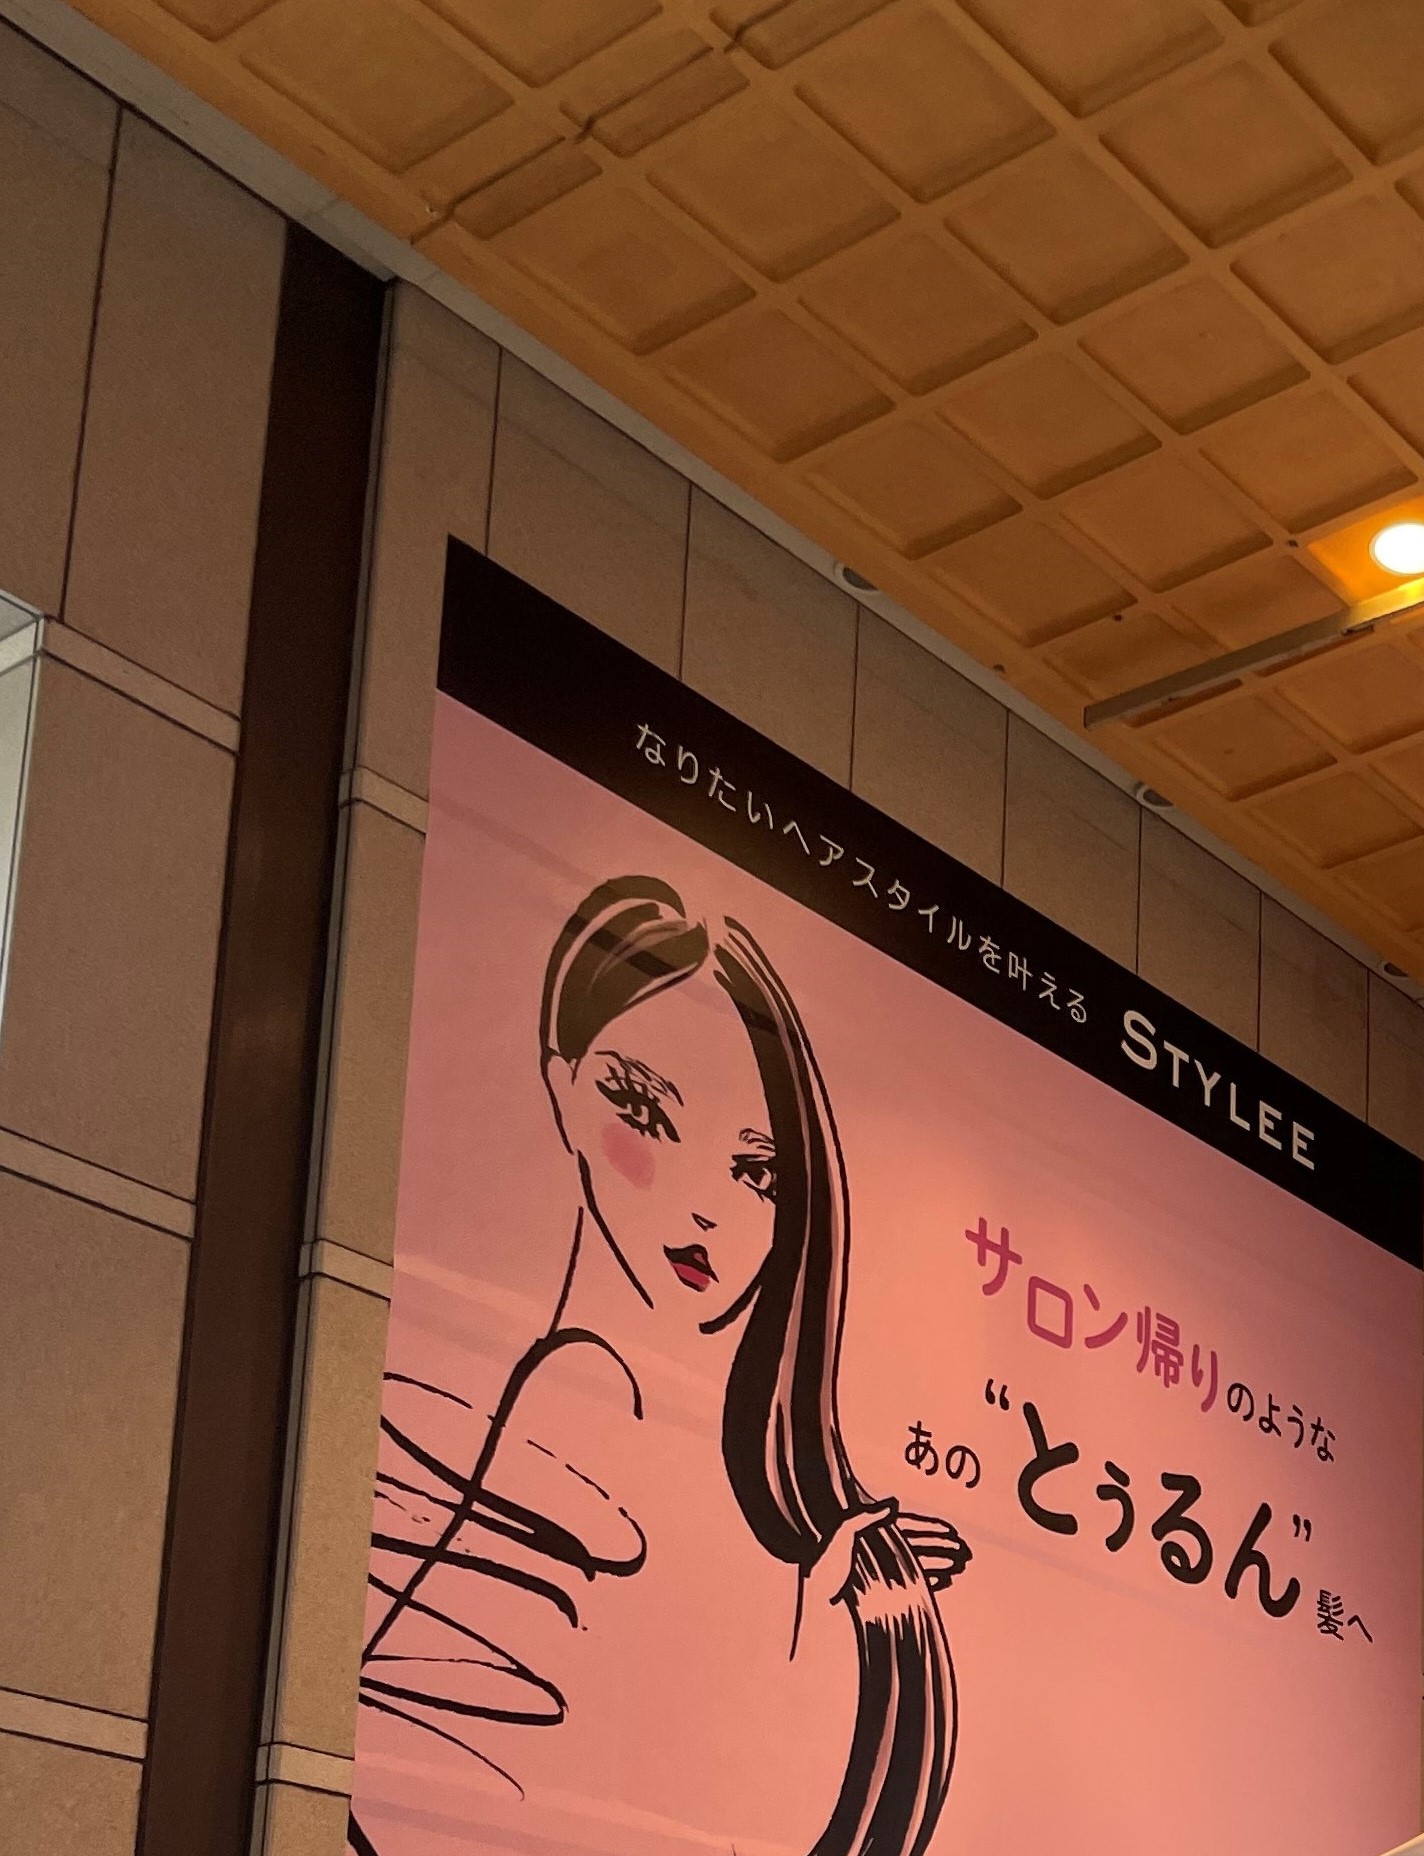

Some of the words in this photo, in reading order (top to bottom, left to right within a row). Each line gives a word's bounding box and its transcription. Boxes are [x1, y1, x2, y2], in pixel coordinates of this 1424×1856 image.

[635, 721, 1088, 1026] なりたいヘアスタイルを叶える
[1120, 1009, 1316, 1171] STYLEE
[965, 1217, 1336, 1462] サロン帰りのような
